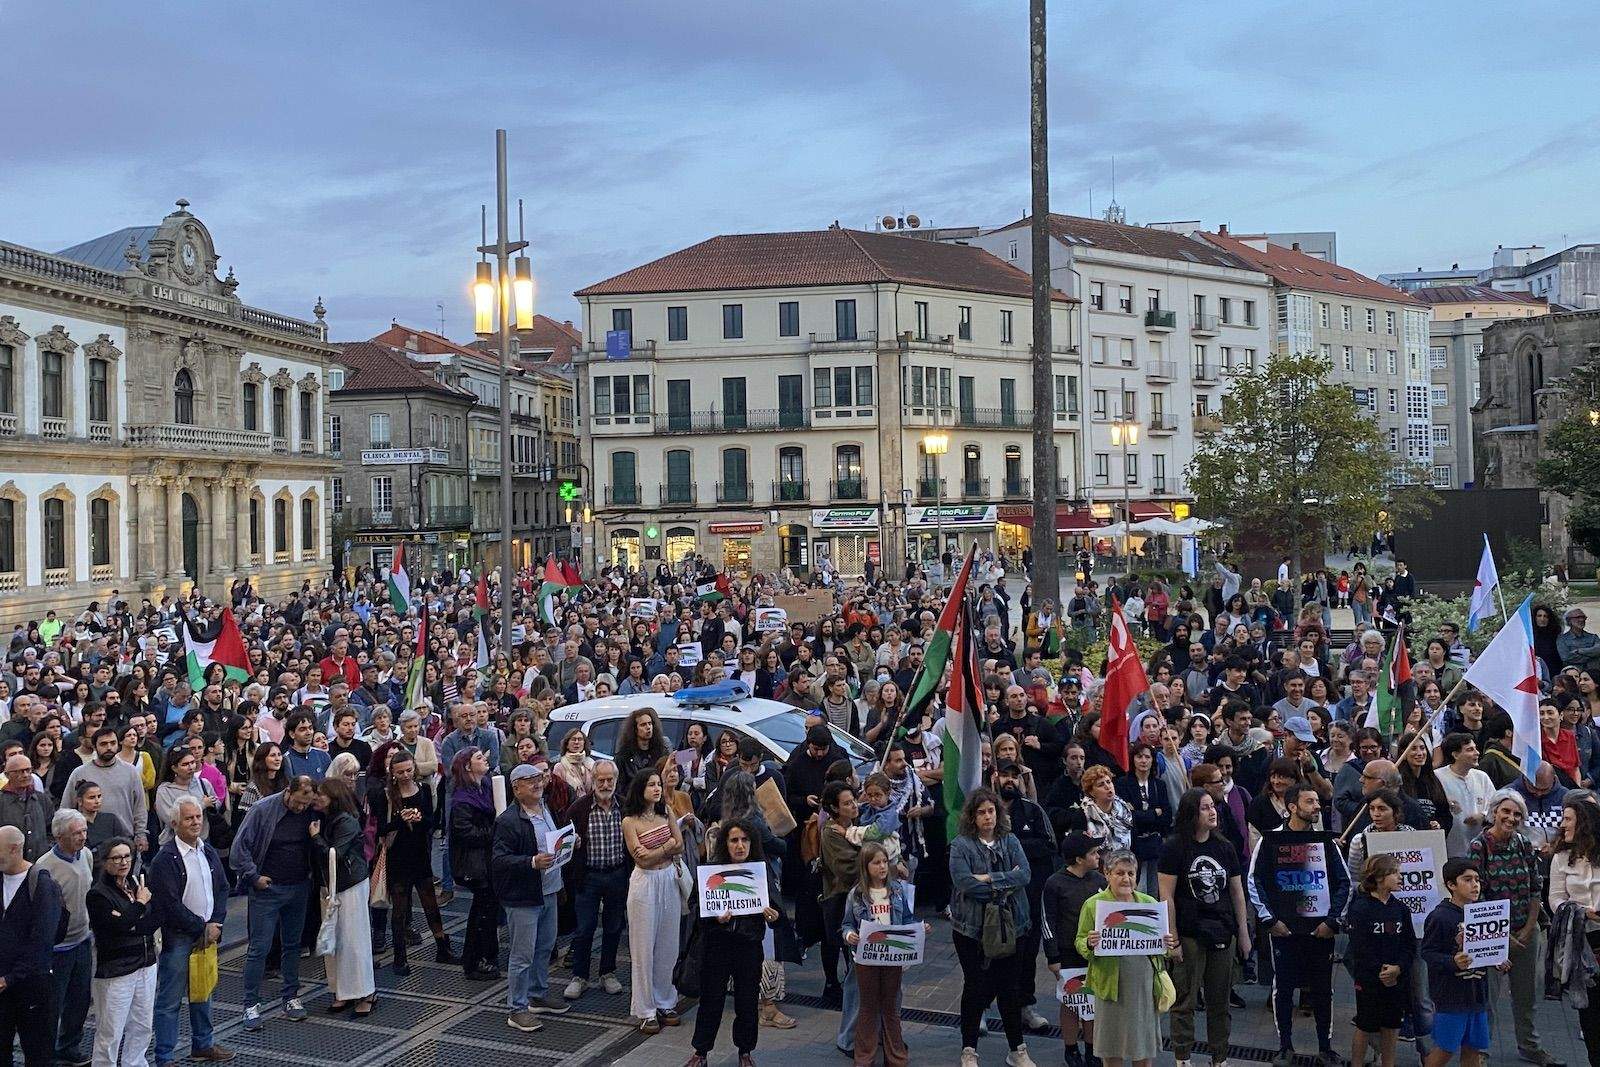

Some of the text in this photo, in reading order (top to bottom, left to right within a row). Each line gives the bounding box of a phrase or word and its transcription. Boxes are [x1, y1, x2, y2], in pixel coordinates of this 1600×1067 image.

[152, 284, 228, 314] CASA CONSISTORIAL
[1276, 870, 1326, 885] STOP
[1400, 870, 1434, 886] TOP
[705, 889, 730, 900] GALIZA
[706, 898, 762, 911] CON PALESTINA
[1101, 928, 1130, 939] GALIZA
[1465, 919, 1509, 936] STOP
[863, 943, 889, 953] GALIZA
[1101, 938, 1163, 950] CON PALESTINA
[862, 952, 918, 962] CON PALESTINA
[1062, 994, 1089, 1004] GALIZA
